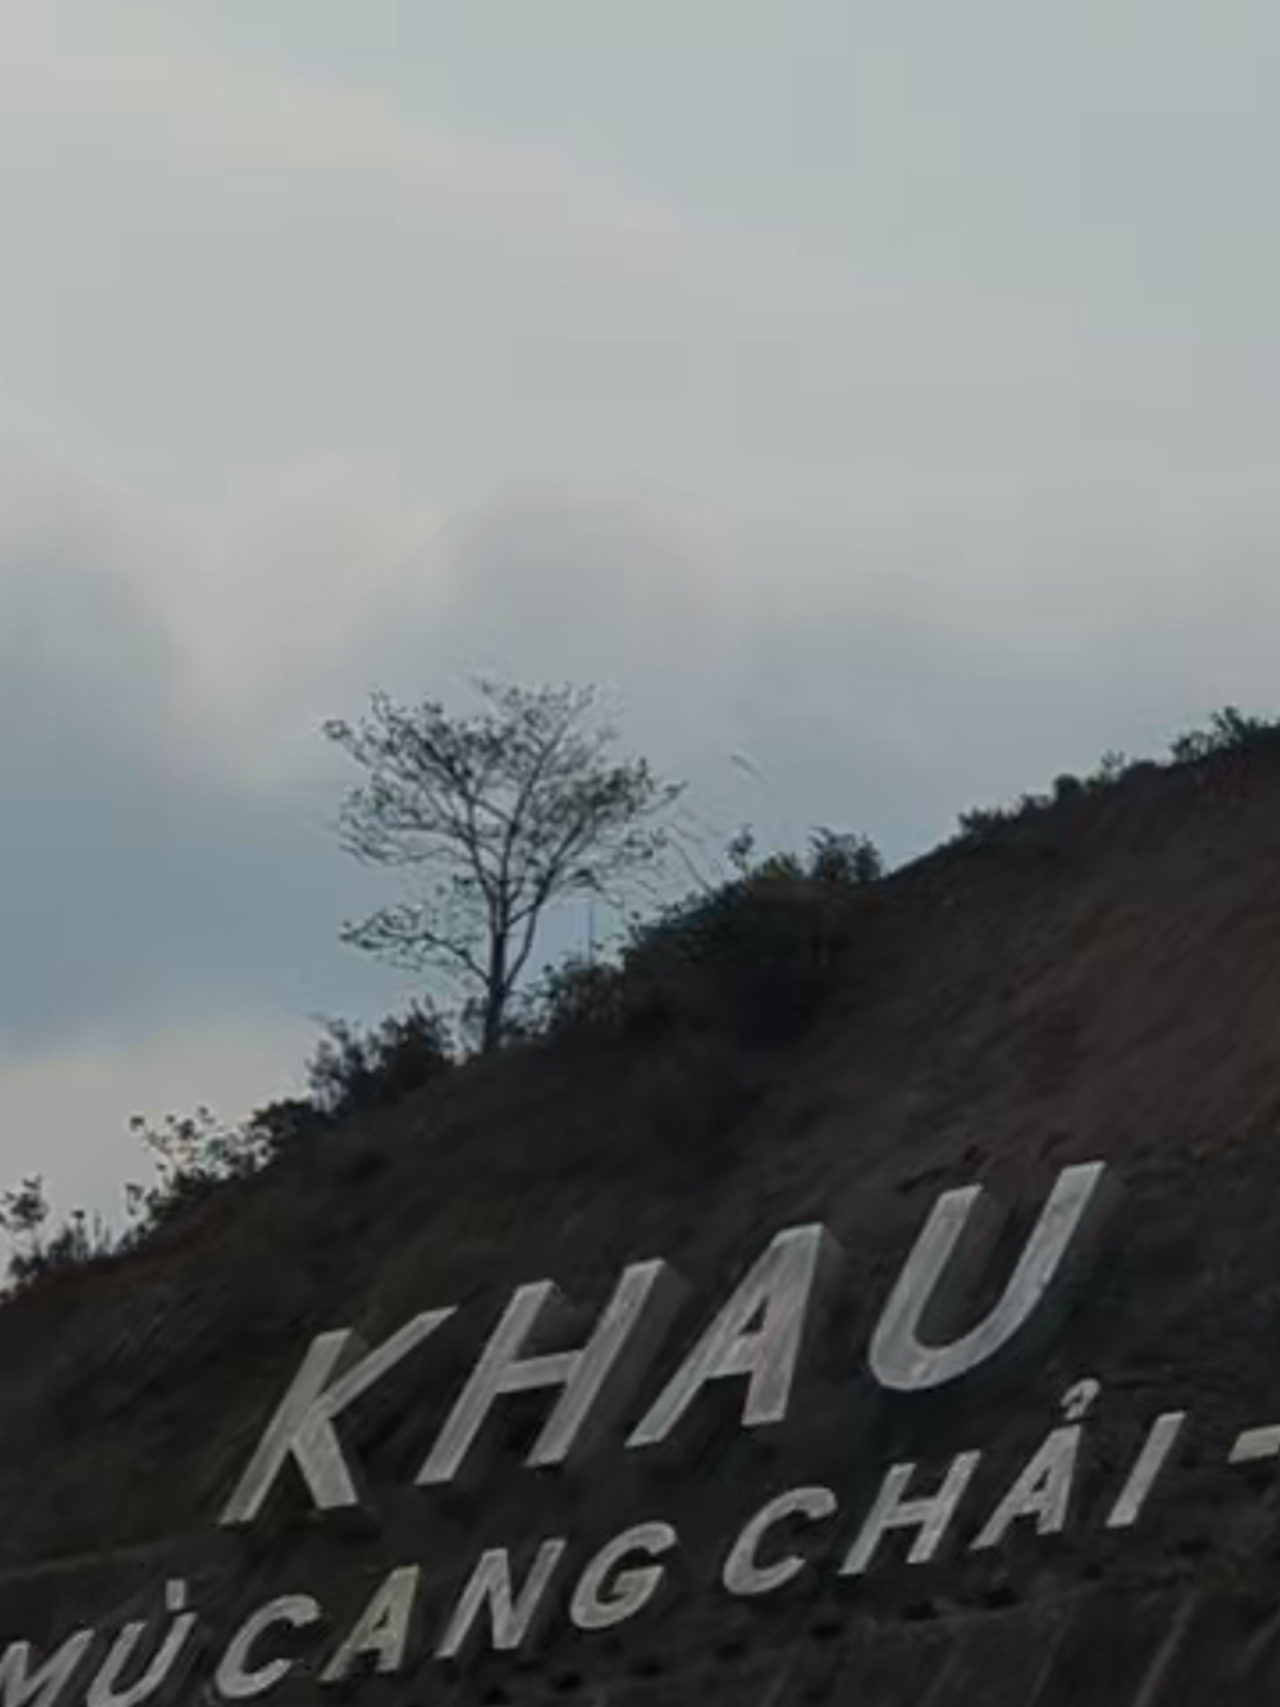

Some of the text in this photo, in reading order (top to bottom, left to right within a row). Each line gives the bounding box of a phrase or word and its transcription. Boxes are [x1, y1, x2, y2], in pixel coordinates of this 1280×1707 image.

[216, 1160, 1108, 1525] KHAU
[212, 1522, 679, 1700] CANG
[721, 1377, 1188, 1597] CHẢI
